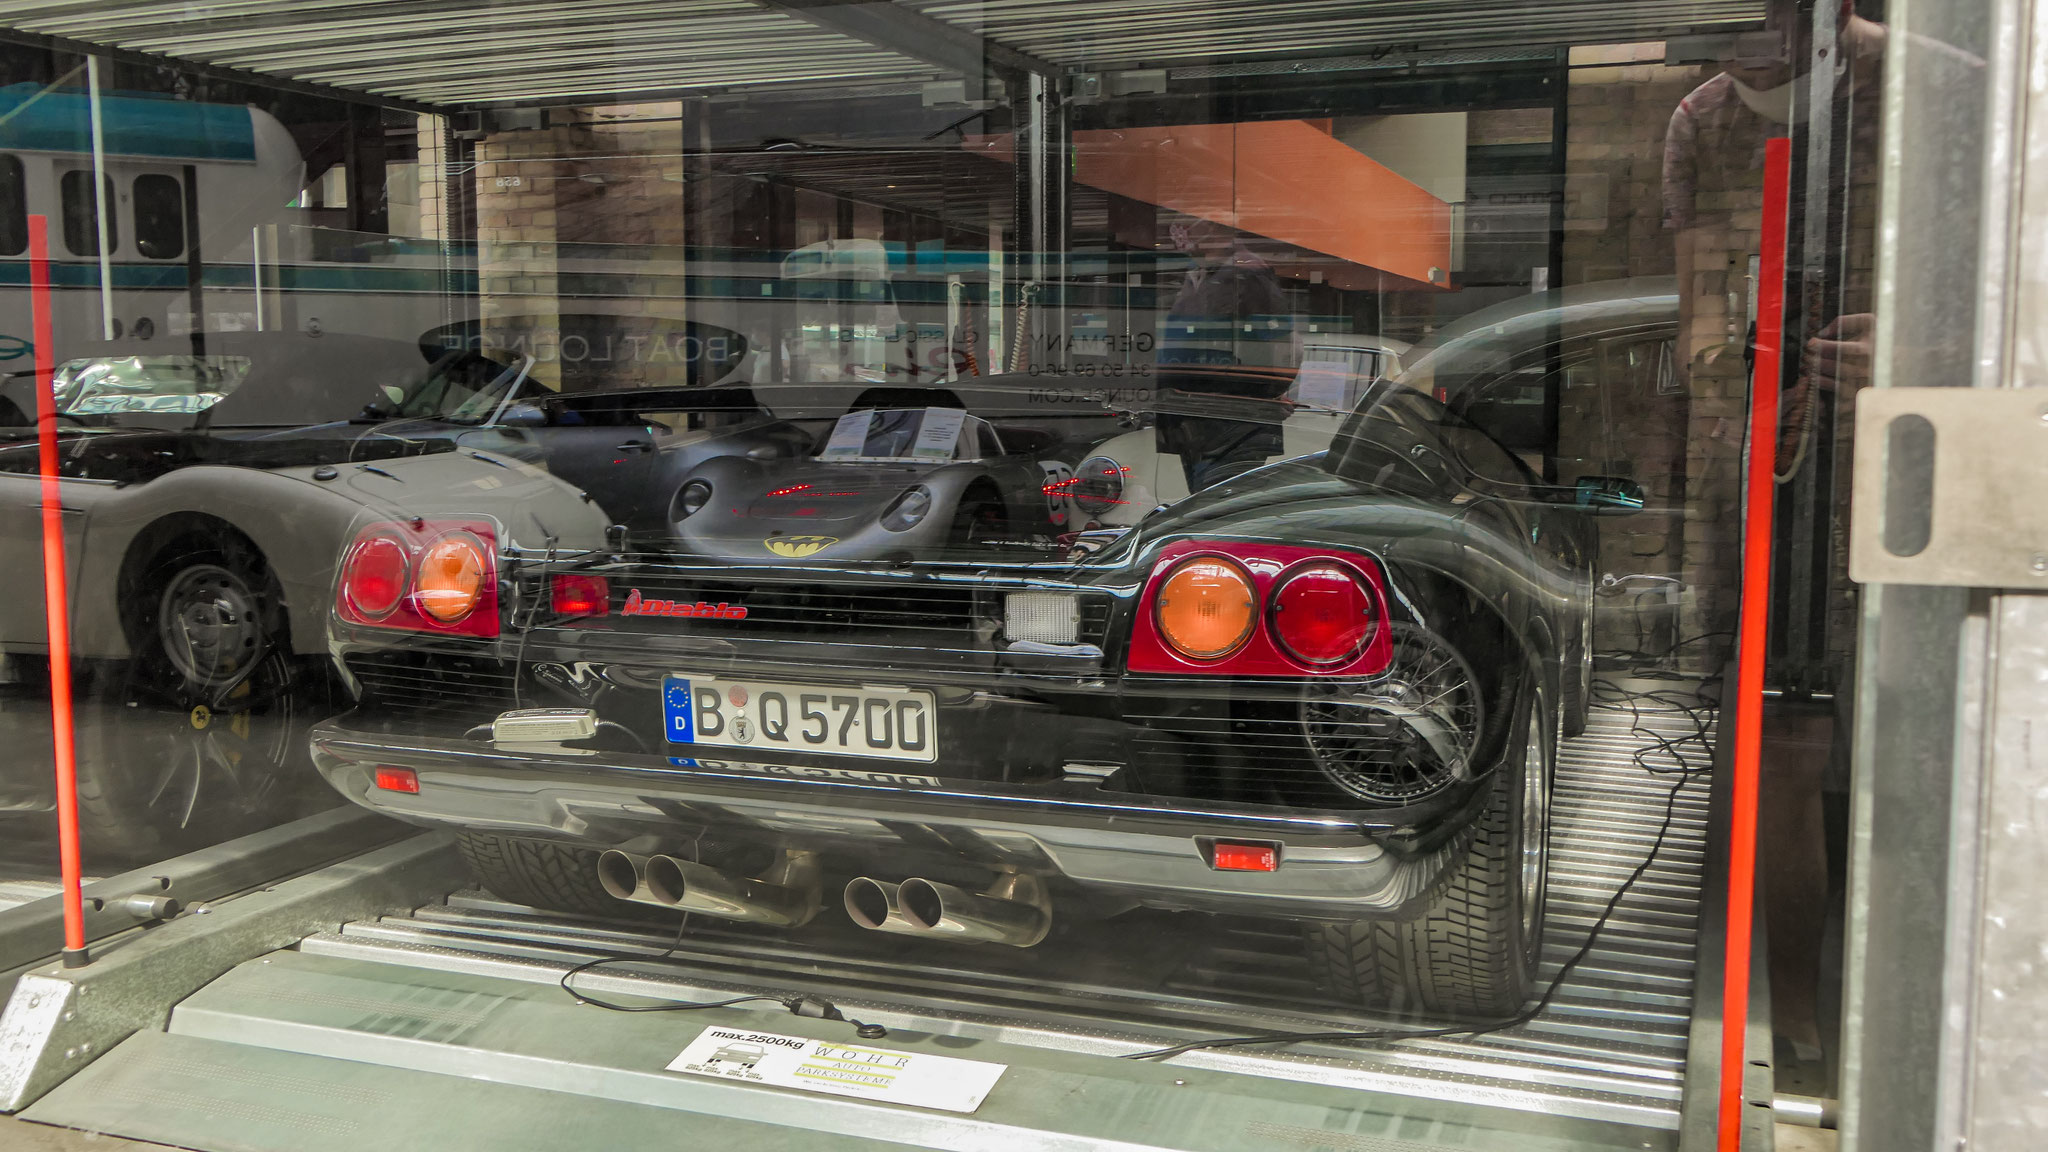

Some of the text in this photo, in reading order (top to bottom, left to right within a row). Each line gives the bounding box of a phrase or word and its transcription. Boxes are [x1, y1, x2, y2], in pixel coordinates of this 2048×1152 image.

[639, 599, 748, 620] Diablo
[674, 716, 686, 731] D
[694, 687, 927, 752] B Q 5700
[710, 1030, 805, 1050] max.2500kg
[832, 1062, 871, 1072] AUTO
